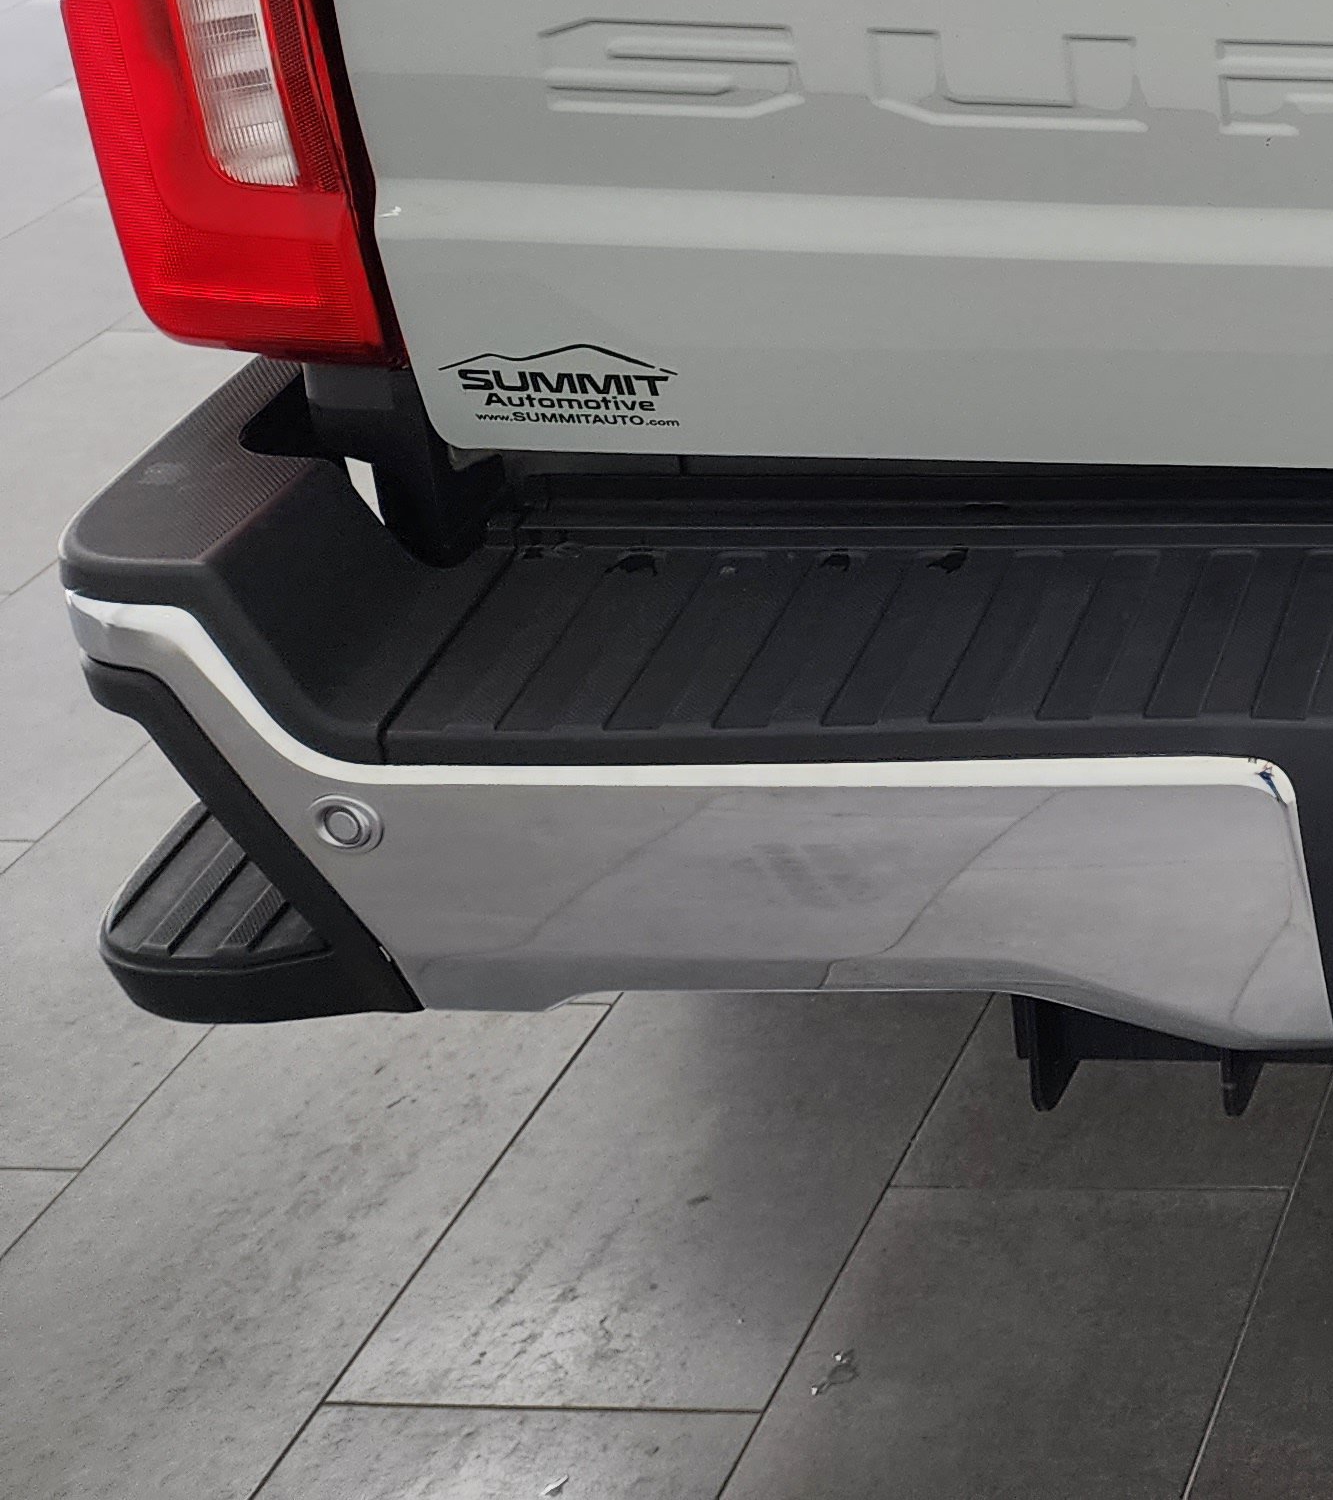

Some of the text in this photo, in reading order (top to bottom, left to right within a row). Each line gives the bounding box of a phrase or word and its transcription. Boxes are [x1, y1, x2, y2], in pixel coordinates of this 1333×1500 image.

[457, 368, 669, 396] SUMMIT
[484, 392, 656, 412] Automotive
[474, 411, 681, 427] www.SUMMITAUTO.com
